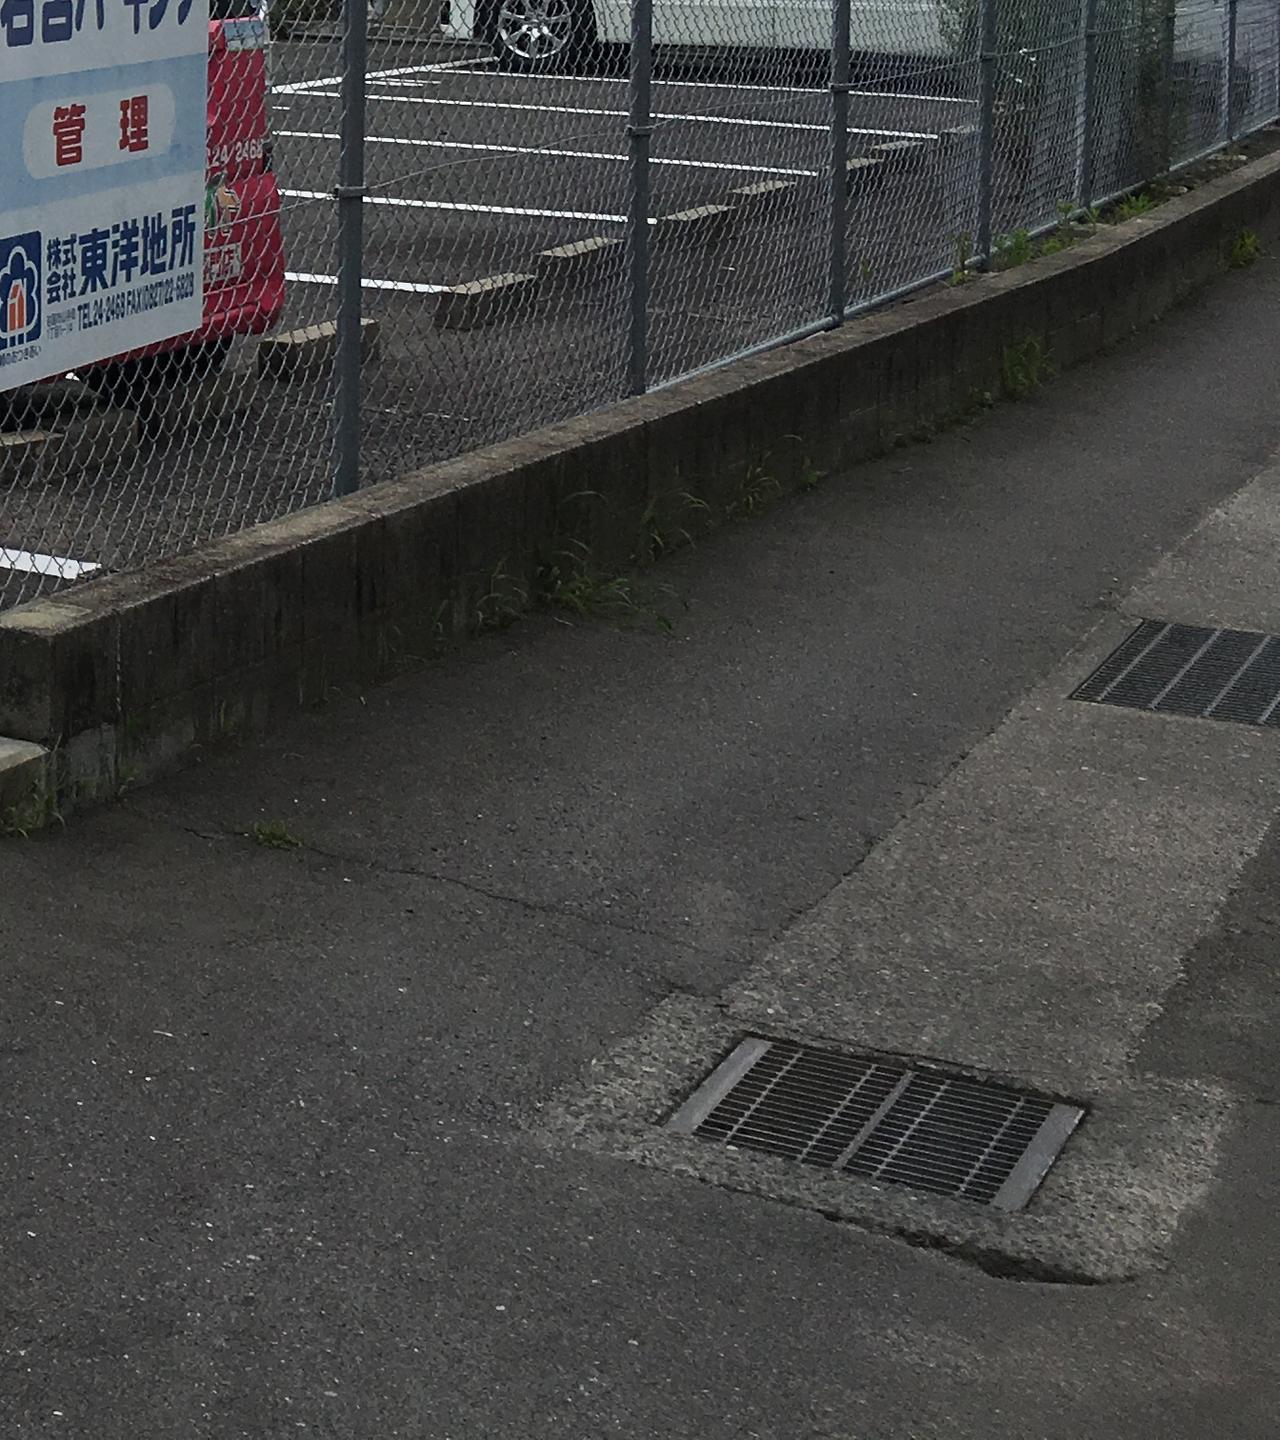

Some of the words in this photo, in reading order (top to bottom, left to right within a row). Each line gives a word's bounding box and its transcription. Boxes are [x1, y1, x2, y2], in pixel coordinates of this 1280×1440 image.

[53, 95, 149, 166] 管理
[78, 205, 196, 296] 東洋地所
